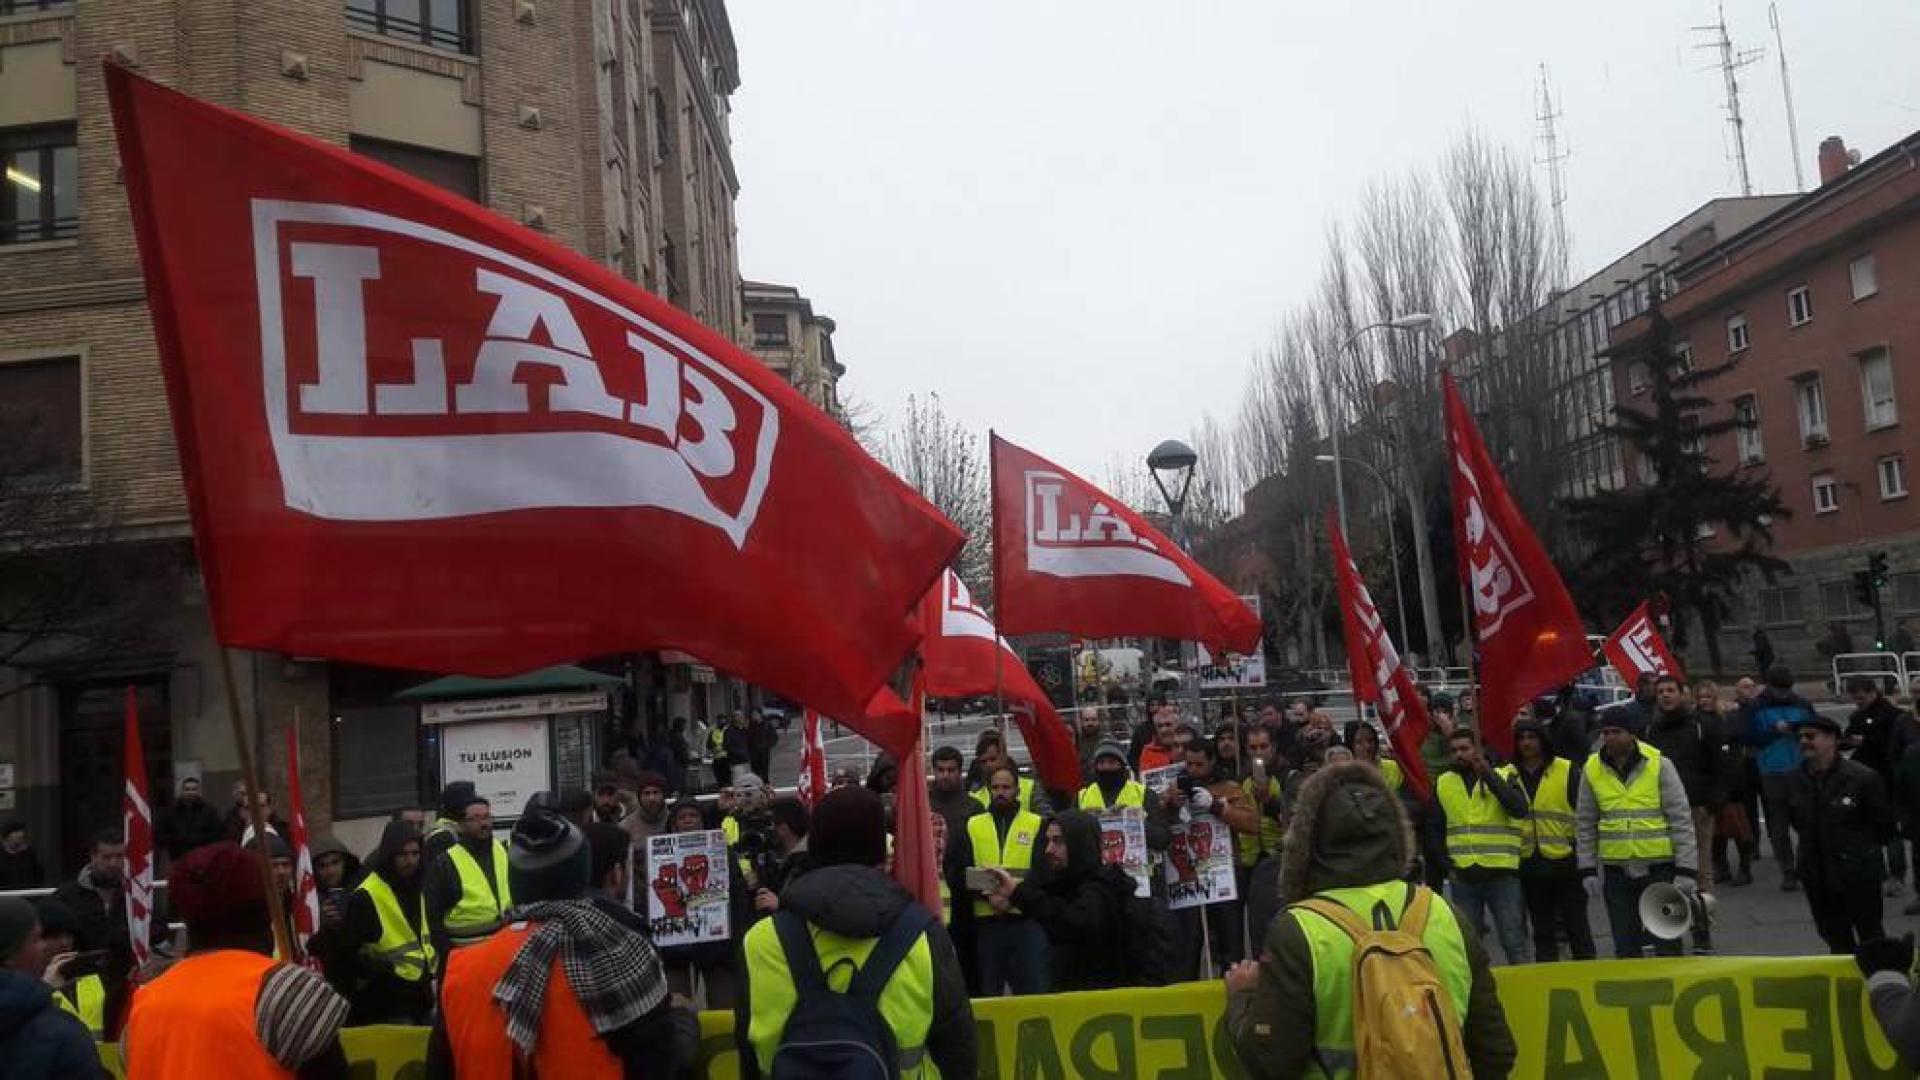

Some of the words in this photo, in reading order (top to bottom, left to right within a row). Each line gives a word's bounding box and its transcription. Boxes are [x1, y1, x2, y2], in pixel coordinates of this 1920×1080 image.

[291, 242, 737, 477] LAB
[1035, 483, 1158, 550] LA
[459, 752, 476, 763] TU
[477, 761, 513, 773] SUMA
